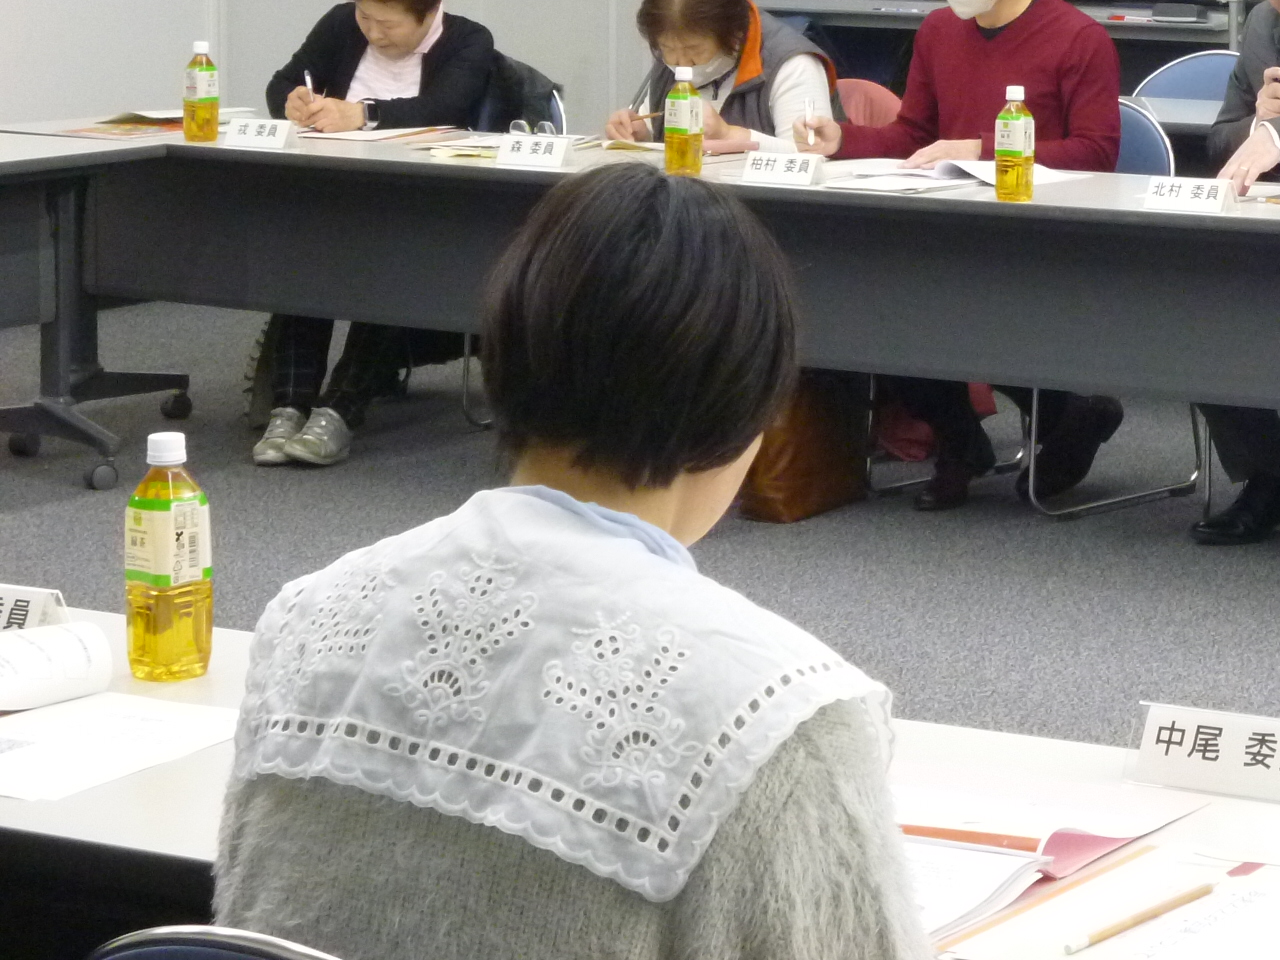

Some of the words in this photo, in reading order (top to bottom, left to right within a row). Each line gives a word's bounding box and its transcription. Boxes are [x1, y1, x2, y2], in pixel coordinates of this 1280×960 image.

[254, 123, 278, 137] 委員
[510, 140, 523, 153] 森
[529, 141, 554, 155] 委員
[750, 156, 777, 171] 柏村
[783, 158, 810, 173] 委員
[1152, 182, 1182, 197] 北村
[1190, 184, 1219, 200] 委員
[0, 596, 31, 630] 員
[1155, 720, 1224, 763] 中尾
